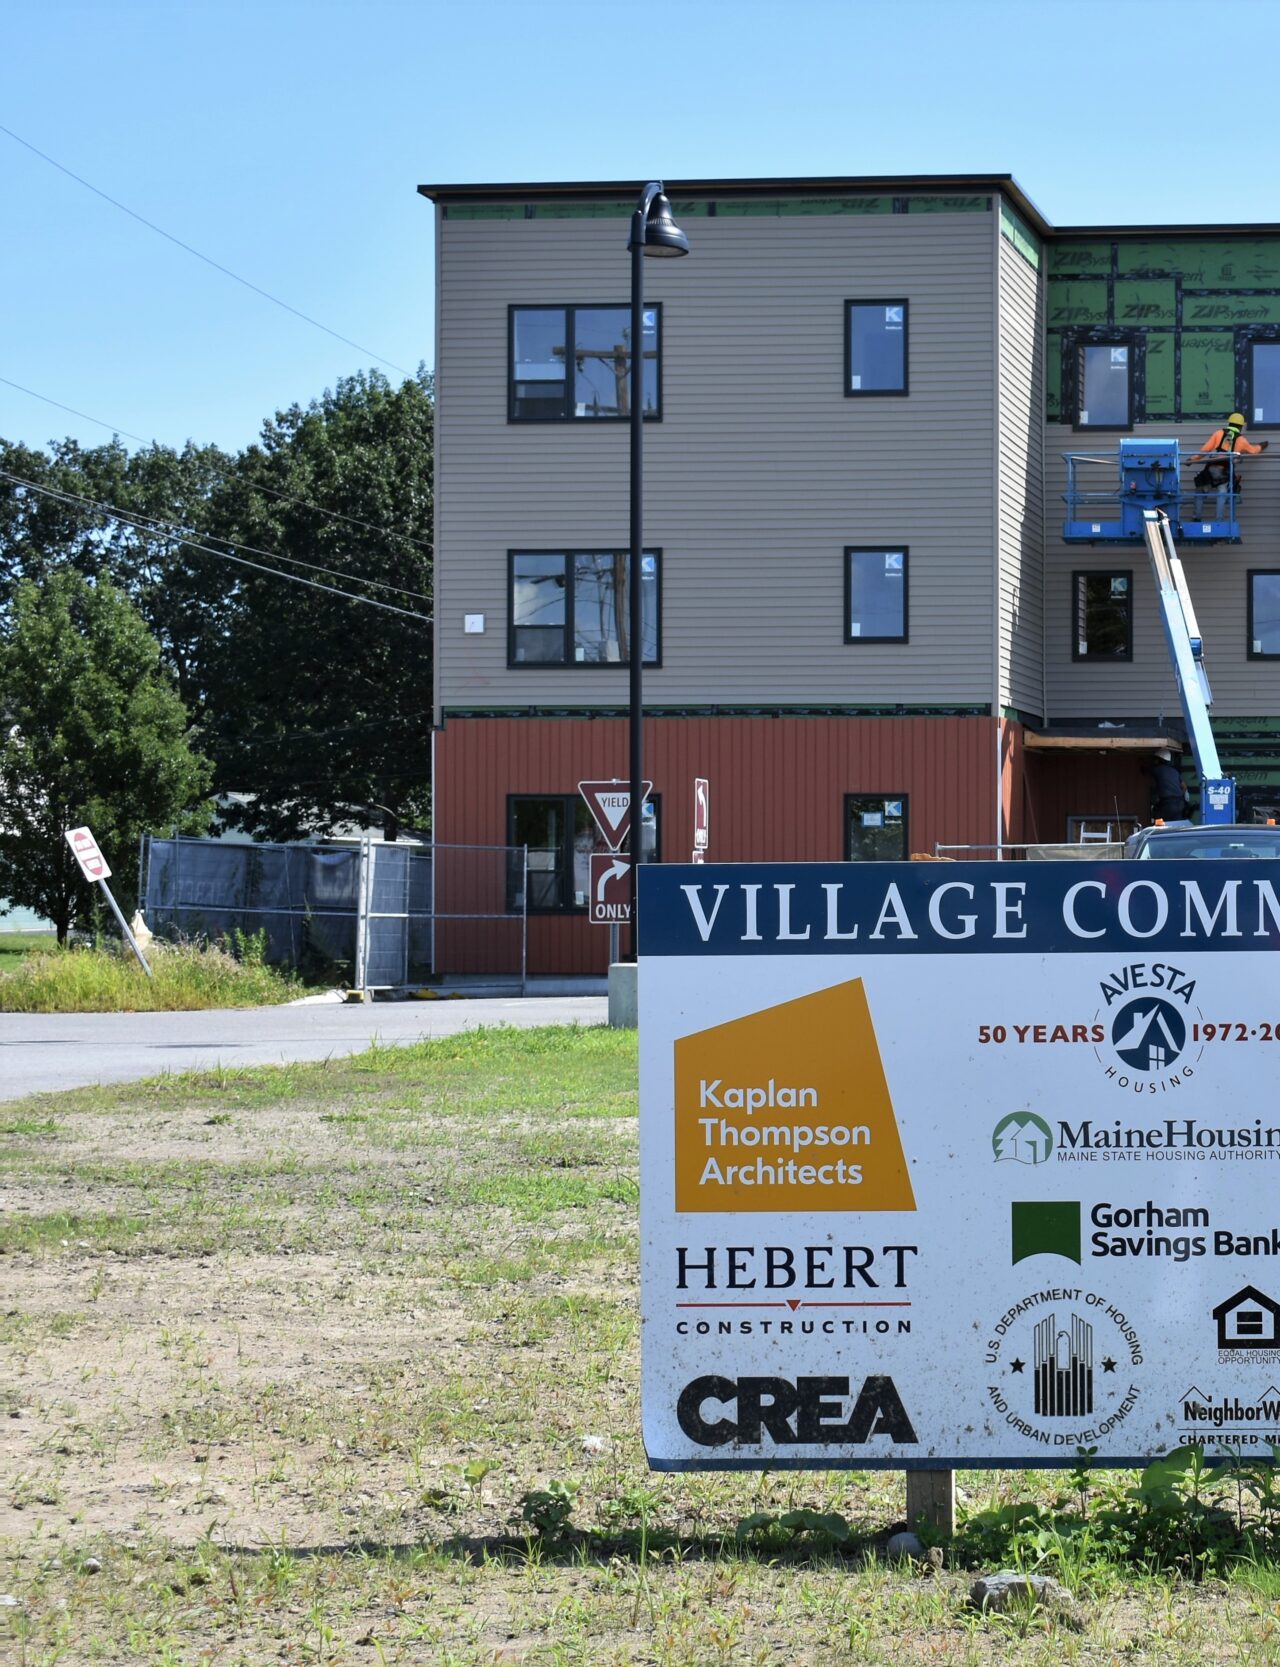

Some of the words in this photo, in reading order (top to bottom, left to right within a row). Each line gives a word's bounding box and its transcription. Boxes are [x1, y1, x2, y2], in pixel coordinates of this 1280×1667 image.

[600, 796, 629, 808] YIELD
[1207, 786, 1231, 795] S-40
[595, 903, 631, 919] ONLY
[681, 881, 1027, 942] VILLAGE
[1099, 963, 1197, 1006] AVESTA
[978, 1025, 1007, 1044] 50
[1013, 1023, 1105, 1043] YEARS
[1104, 1065, 1194, 1094] HOUSING
[700, 1078, 818, 1115] Kaplan
[698, 1117, 871, 1153] Thompson
[698, 1156, 863, 1185] Architects
[1057, 1151, 1098, 1162] MAINE
[1102, 1151, 1142, 1161] STATE
[1146, 1150, 1206, 1161] HOUSING
[1091, 1201, 1210, 1228] Gorham
[1091, 1230, 1206, 1262] Savings
[675, 1245, 919, 1289] HEBERT
[676, 1320, 912, 1334] CONSTRUCTION
[985, 1339, 1002, 1364] U.S.
[994, 1288, 1082, 1336] DEPARTMENT
[1085, 1292, 1107, 1308] OF
[1105, 1304, 1144, 1366] HOUSING
[677, 1374, 919, 1447] CREA
[987, 1386, 1008, 1413] AND
[1005, 1412, 1051, 1445] URBAN
[1054, 1384, 1141, 1446] DEVELOPMENT
[1178, 1434, 1259, 1446] CHARTERED
